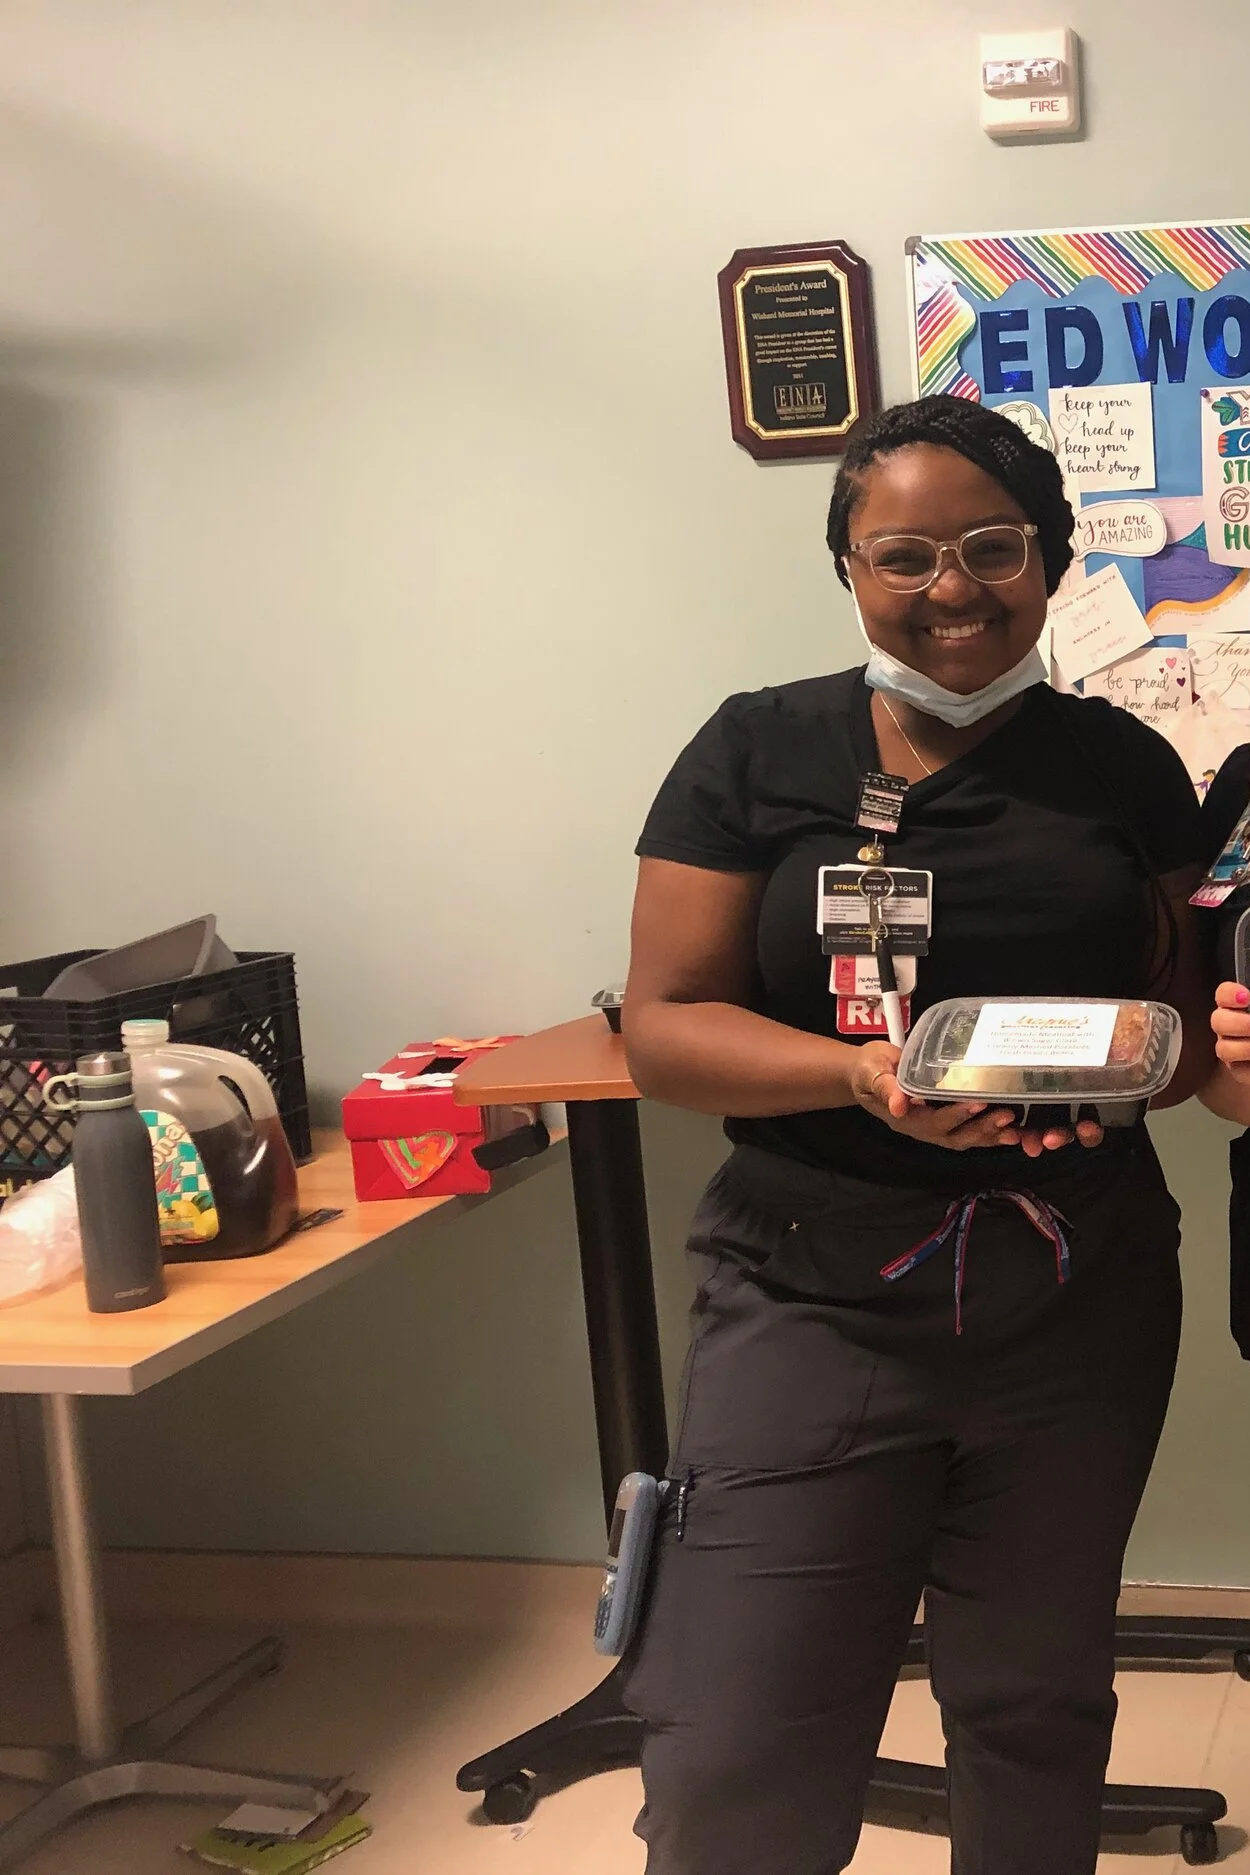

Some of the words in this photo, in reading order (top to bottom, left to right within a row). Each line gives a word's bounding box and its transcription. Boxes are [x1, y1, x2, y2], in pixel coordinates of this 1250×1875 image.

[1030, 100, 1060, 112] FIRE
[754, 282, 798, 294] President's
[800, 279, 827, 290] Award
[778, 309, 807, 318] Memorial
[808, 307, 835, 316] Hospital
[979, 305, 1104, 394] ED
[779, 385, 822, 406] ENA
[1062, 393, 1094, 417] keep
[1099, 399, 1132, 416] your
[1080, 420, 1114, 437] head
[1120, 428, 1134, 440] up
[1060, 437, 1090, 460] keep
[1096, 444, 1128, 458] your
[1065, 460, 1105, 474] heart
[1108, 460, 1141, 480] strong
[1077, 518, 1118, 546] you
[1124, 515, 1146, 525] are
[1099, 525, 1153, 546] AMAZING
[1104, 668, 1123, 690] be
[1129, 673, 1169, 695] proud
[1121, 695, 1145, 710] how
[1151, 696, 1180, 712] hard
